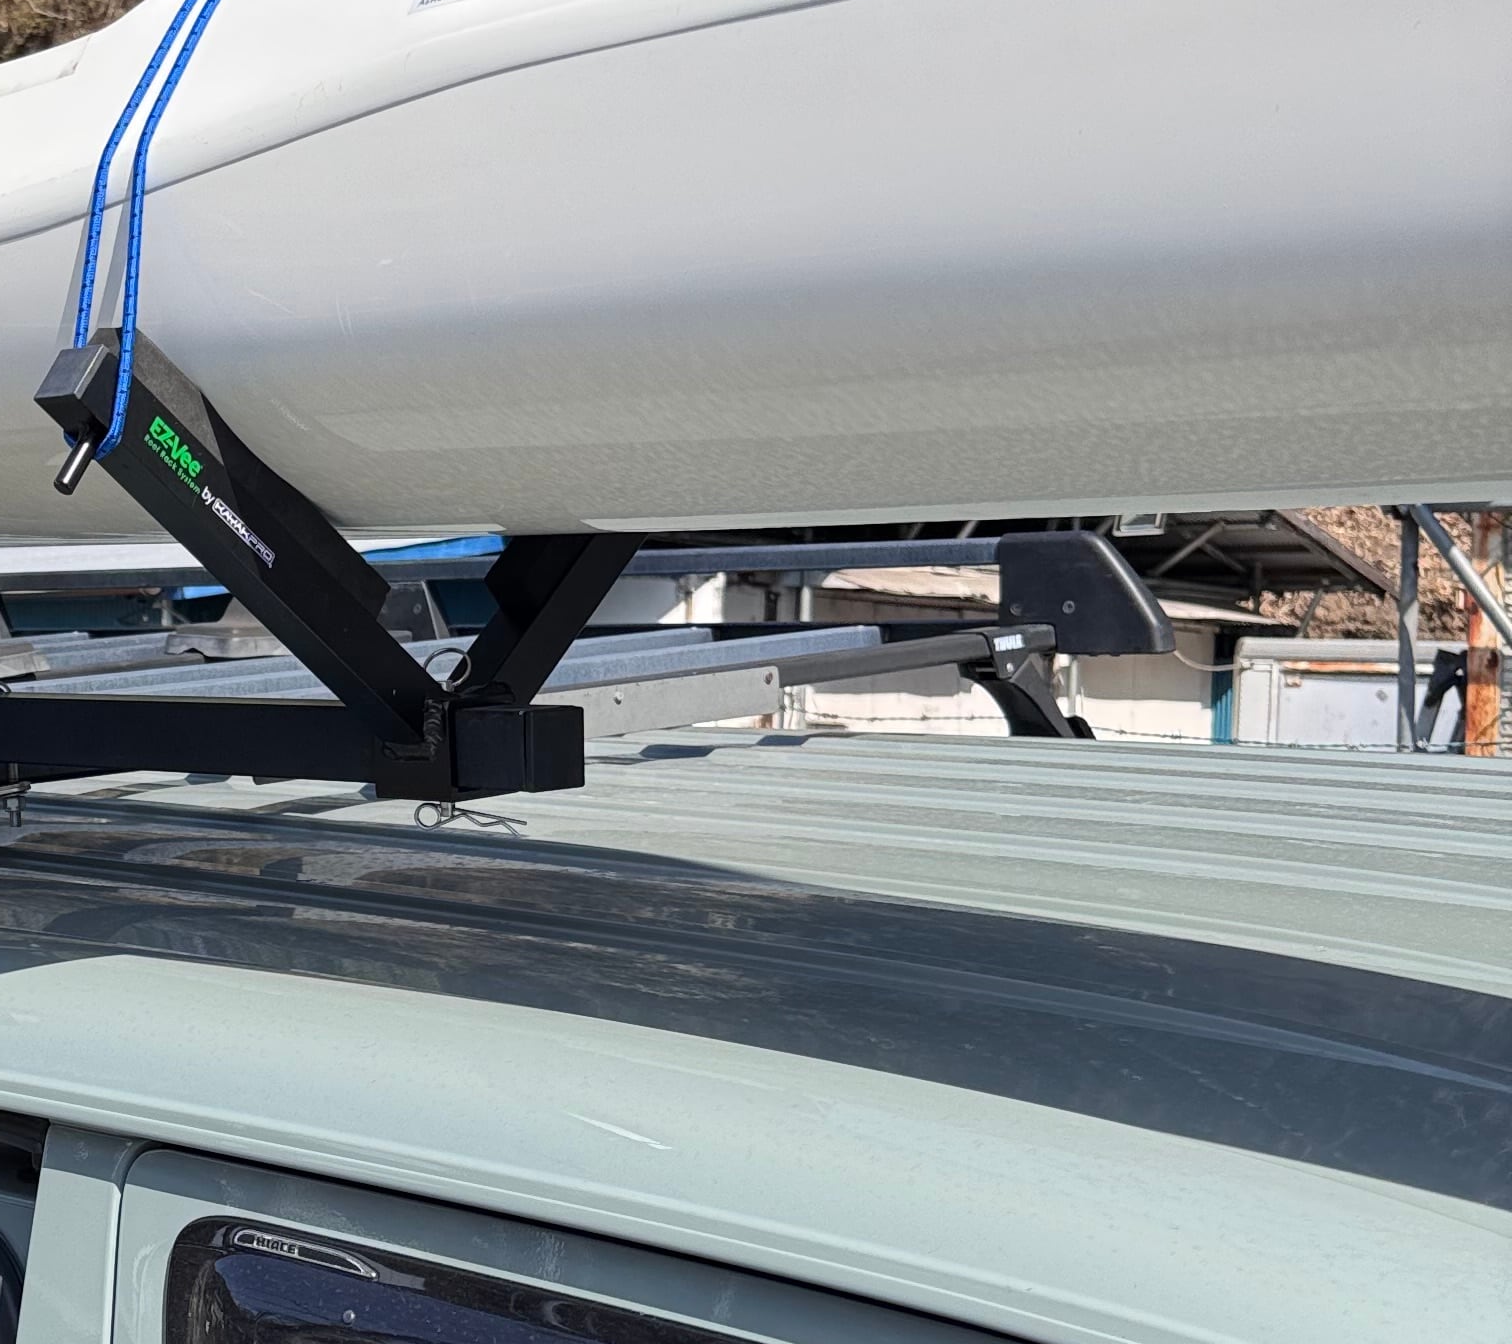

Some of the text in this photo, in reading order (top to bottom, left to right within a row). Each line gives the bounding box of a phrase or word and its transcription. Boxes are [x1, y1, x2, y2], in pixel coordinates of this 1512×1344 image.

[159, 450, 177, 471] Rack
[177, 468, 201, 494] System
[201, 485, 275, 565] by KAYAKPRO
[255, 1235, 296, 1255] HIACE
